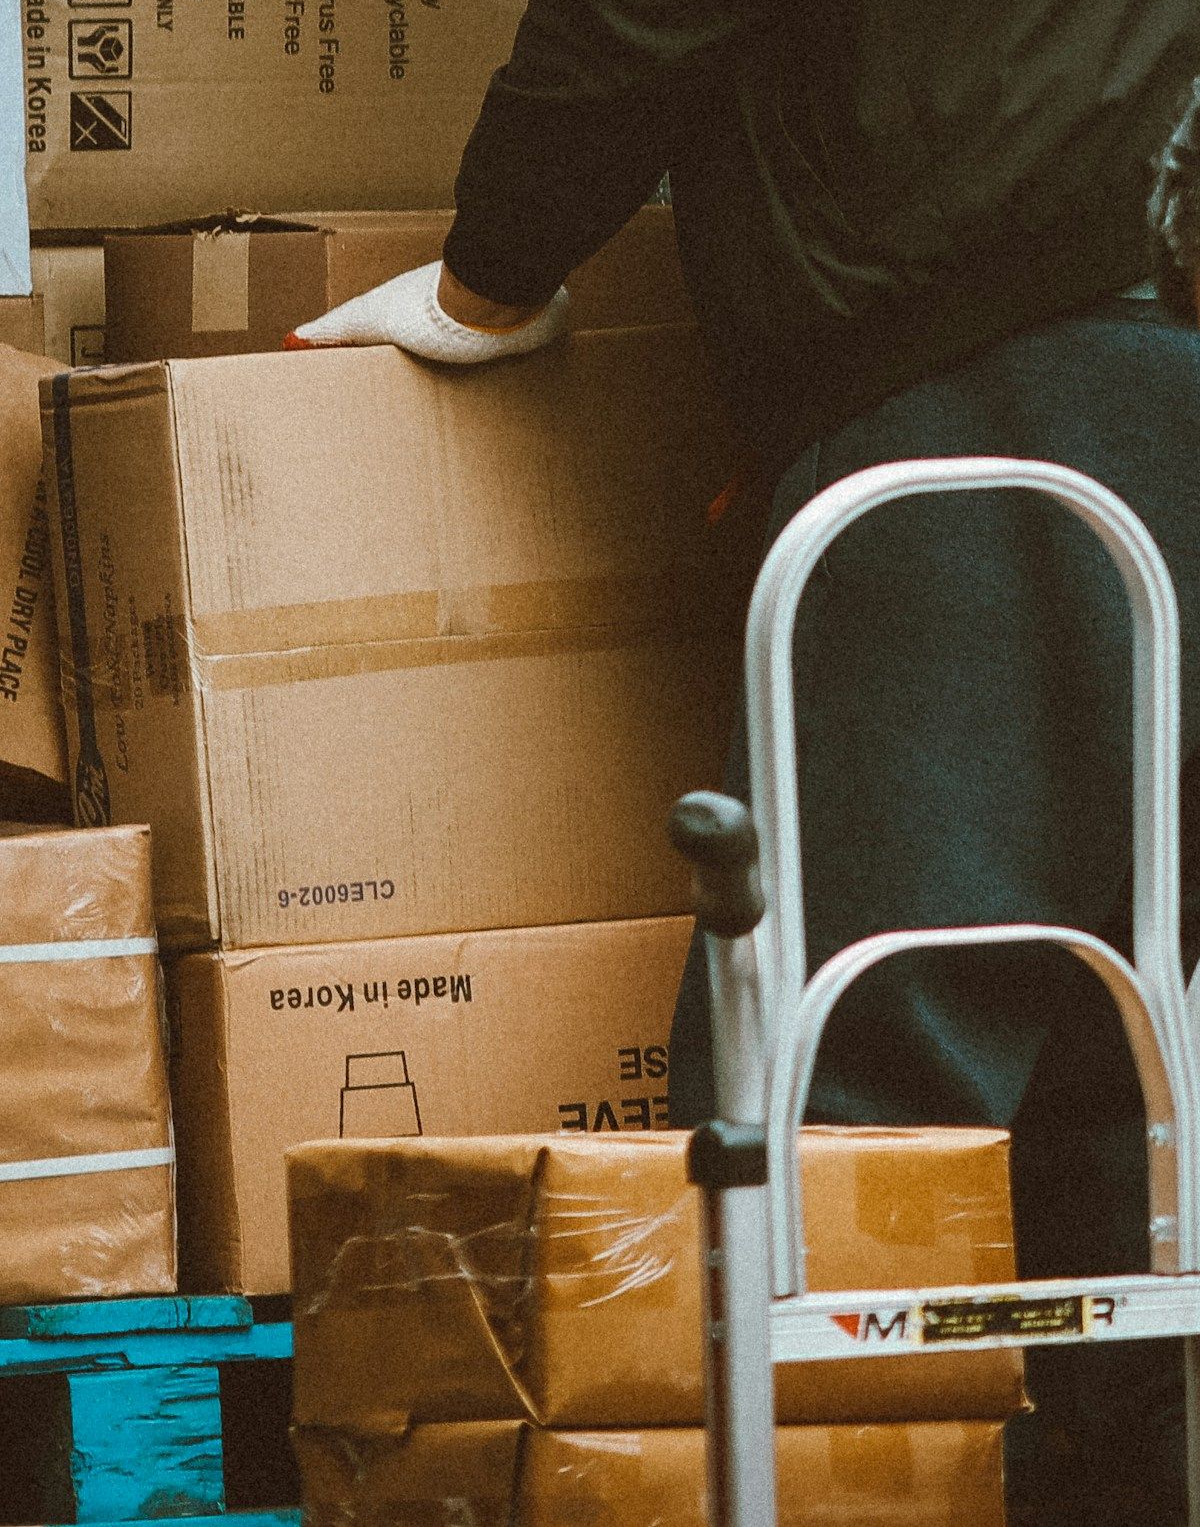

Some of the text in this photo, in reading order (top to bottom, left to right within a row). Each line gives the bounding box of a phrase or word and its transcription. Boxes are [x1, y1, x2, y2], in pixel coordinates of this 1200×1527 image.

[284, 0, 305, 56] Free
[27, 46, 51, 70] in
[318, 38, 340, 94] Free
[27, 77, 52, 153] Korea
[10, 586, 37, 633] DRY
[278, 879, 395, 908] CLE6002-6
[269, 974, 473, 1012] Made in Korea
